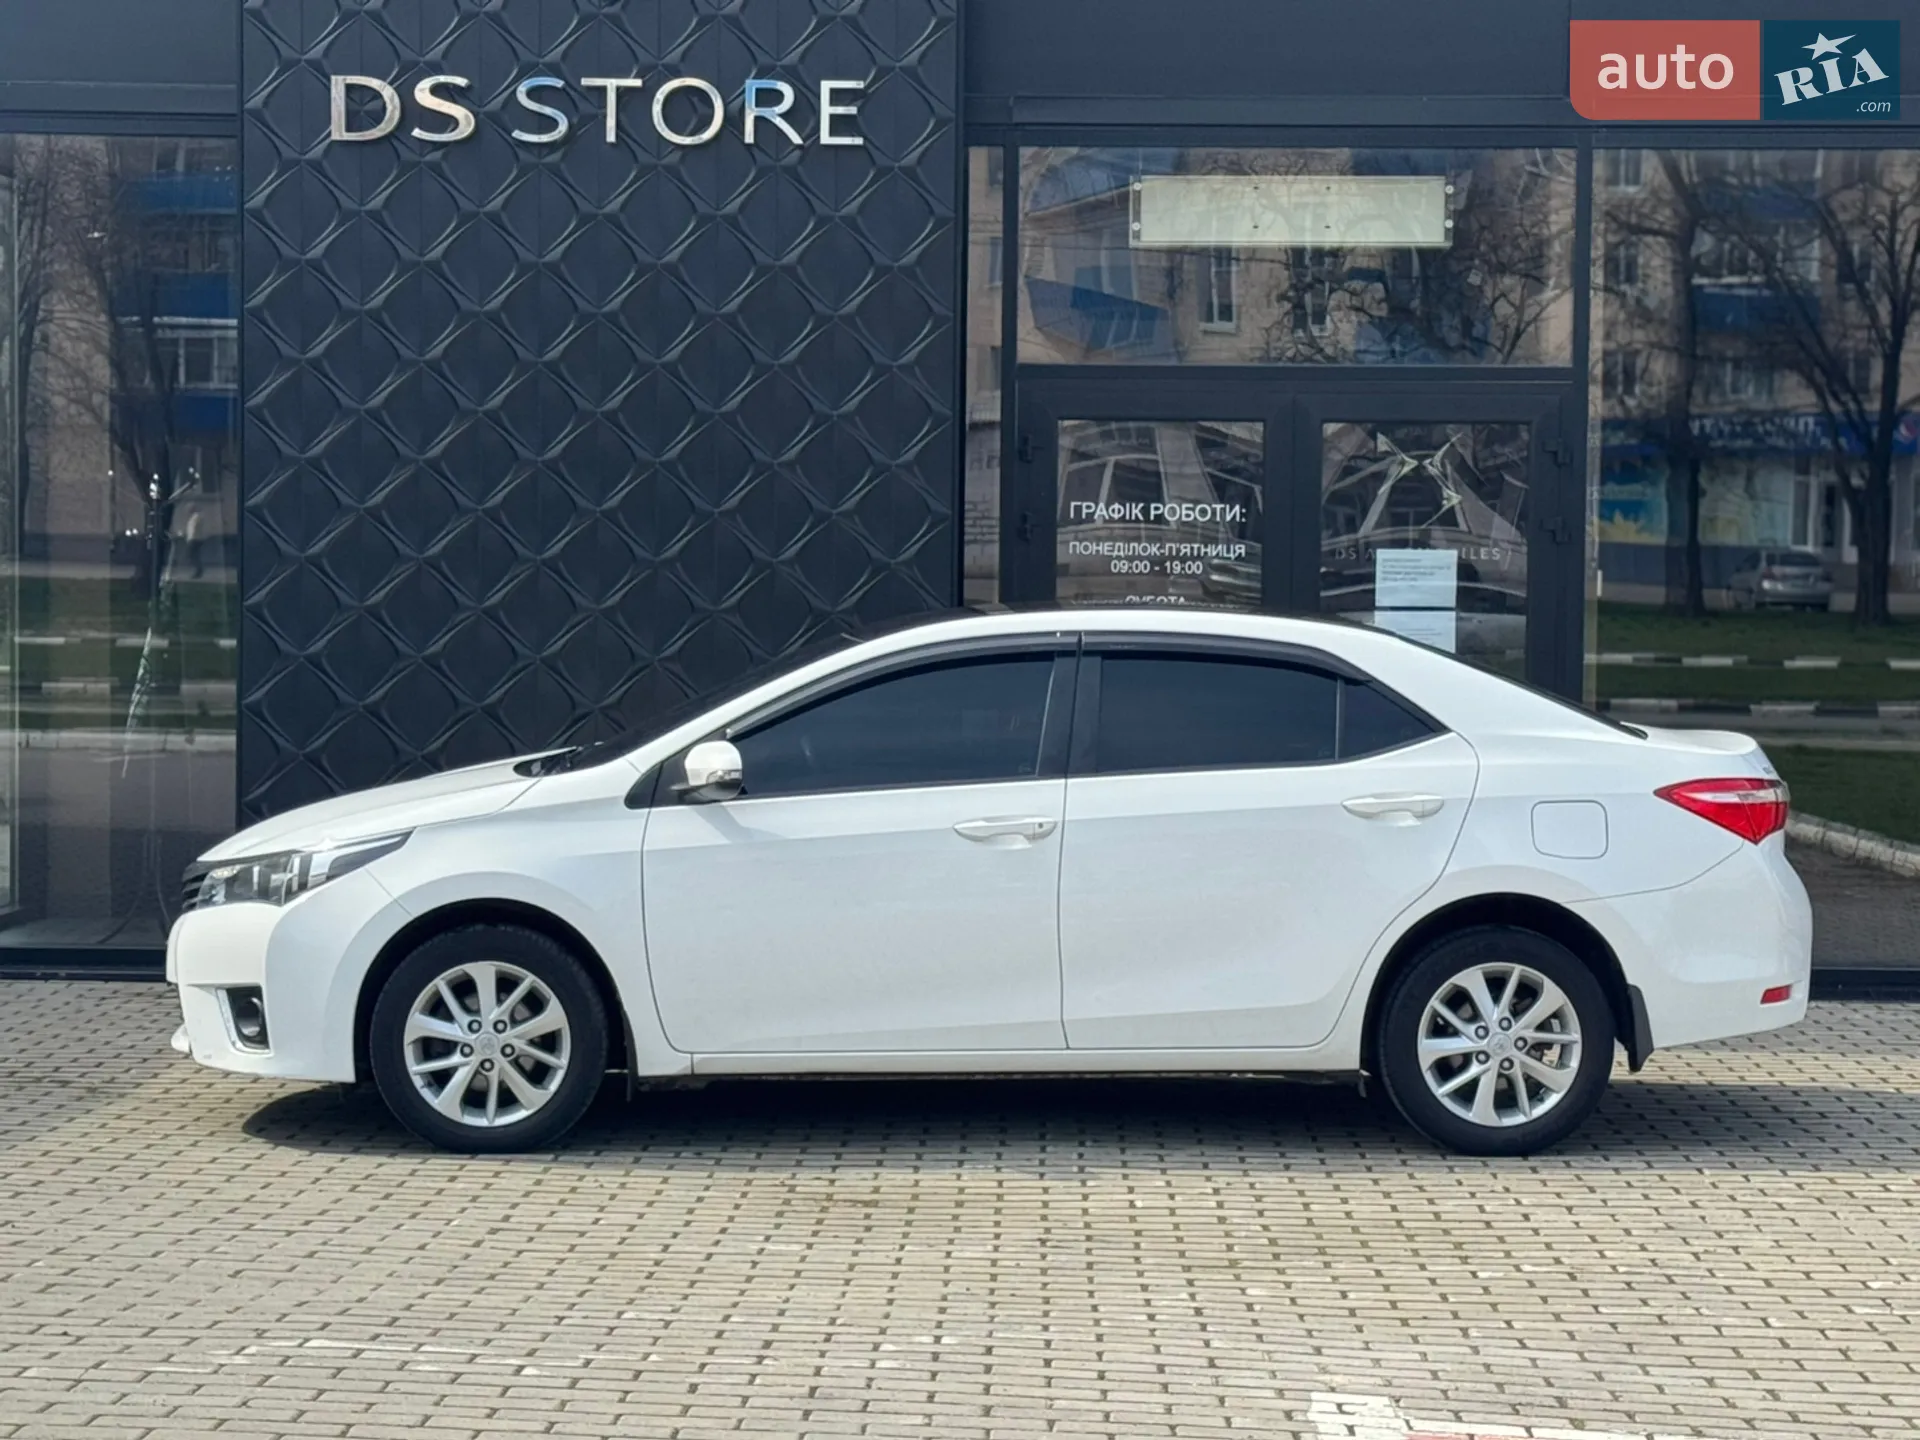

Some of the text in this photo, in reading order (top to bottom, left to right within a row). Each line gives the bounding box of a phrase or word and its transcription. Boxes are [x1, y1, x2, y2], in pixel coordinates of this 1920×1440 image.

[329, 75, 866, 146] DS STORE
[1069, 501, 1248, 523] ГРАФІК РОБОТИ:
[1110, 560, 1151, 574] 09:00
[1164, 561, 1204, 575] 19:00
